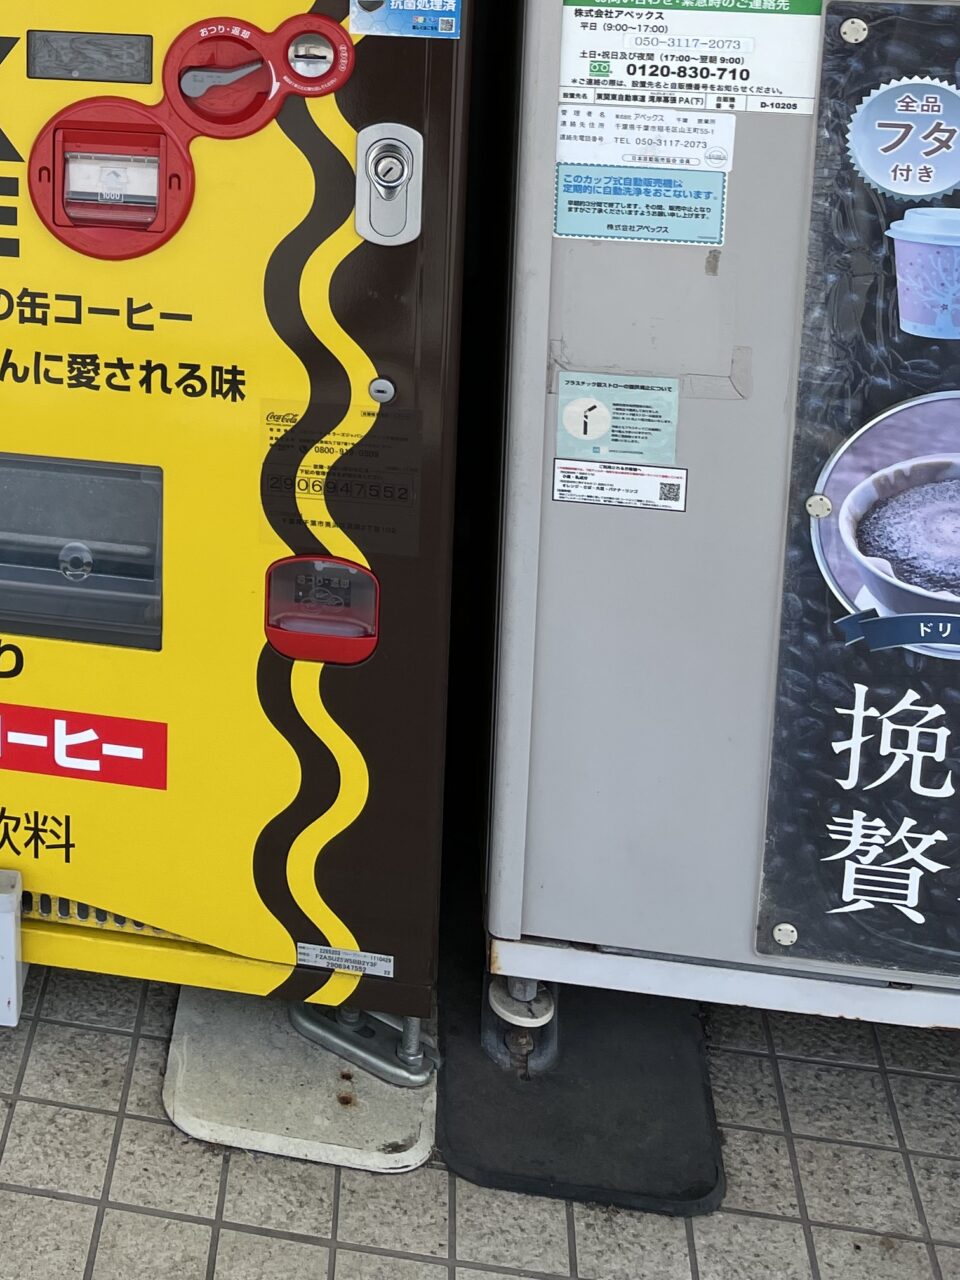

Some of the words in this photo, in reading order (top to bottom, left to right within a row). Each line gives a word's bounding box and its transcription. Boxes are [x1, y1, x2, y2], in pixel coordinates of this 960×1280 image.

[198, 25, 252, 40] おつり・返却
[634, 36, 741, 51] 050-3117-2073
[626, 63, 751, 82] 0120-830-710
[896, 94, 942, 114] 全品
[614, 137, 631, 145] TEL
[635, 137, 708, 149] 050-3117-2073
[876, 120, 959, 157] フタ
[890, 164, 935, 183] 付き
[101, 191, 121, 201] 1000
[919, 621, 953, 638] ドリ
[831, 682, 956, 798] 挽
[820, 809, 951, 925] 贅
